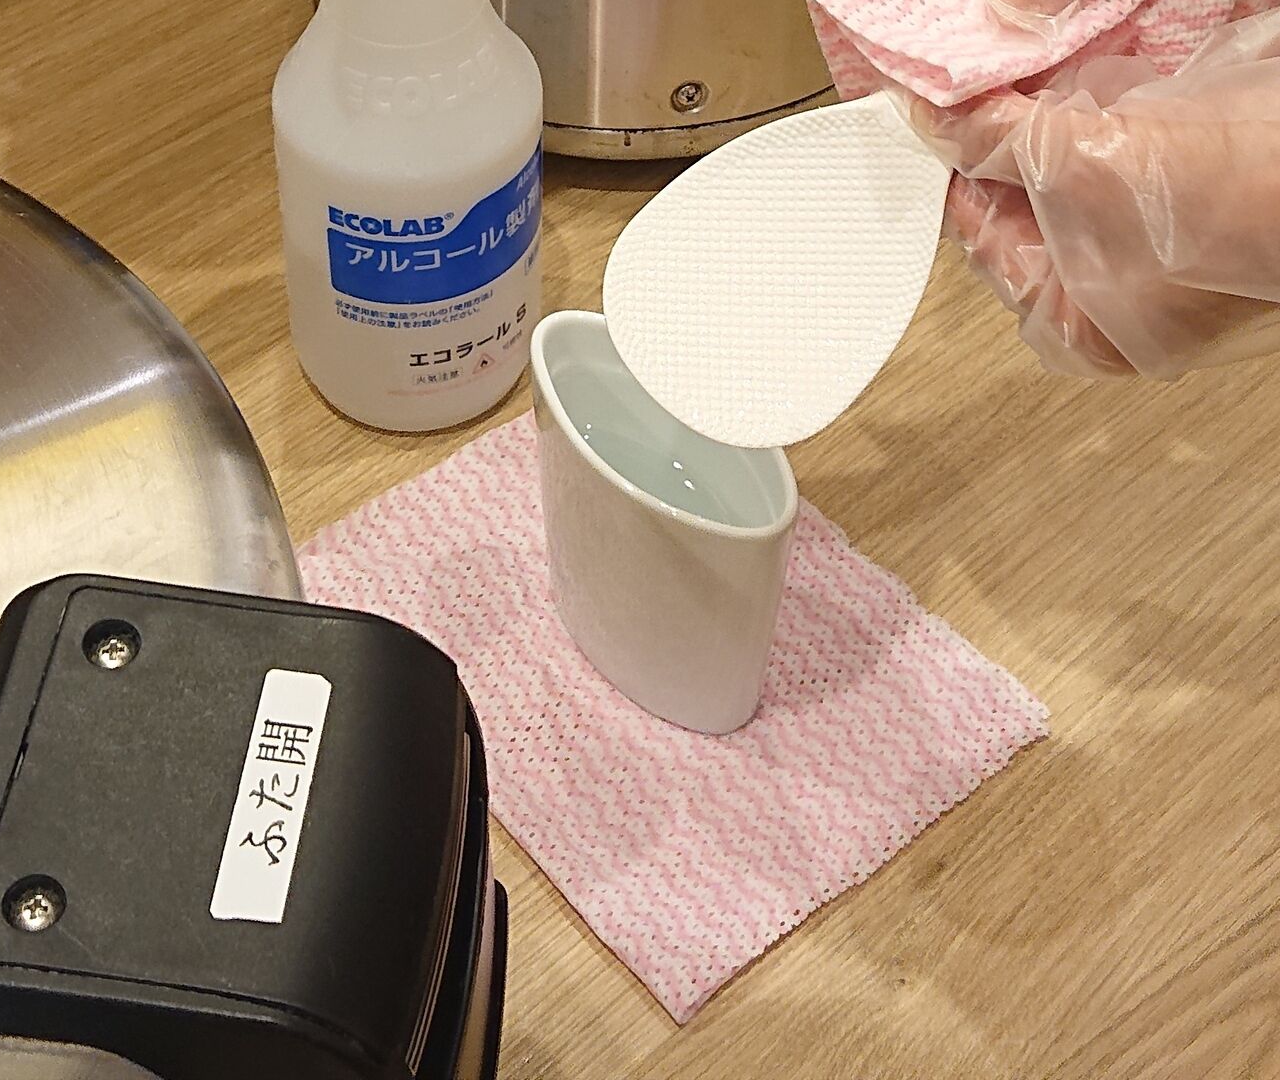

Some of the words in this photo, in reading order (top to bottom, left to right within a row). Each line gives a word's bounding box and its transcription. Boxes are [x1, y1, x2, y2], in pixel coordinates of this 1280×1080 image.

[328, 206, 445, 237] ECOLAB
[409, 322, 512, 367] エコラール
[516, 302, 528, 324] S
[239, 718, 313, 866] ふた開
